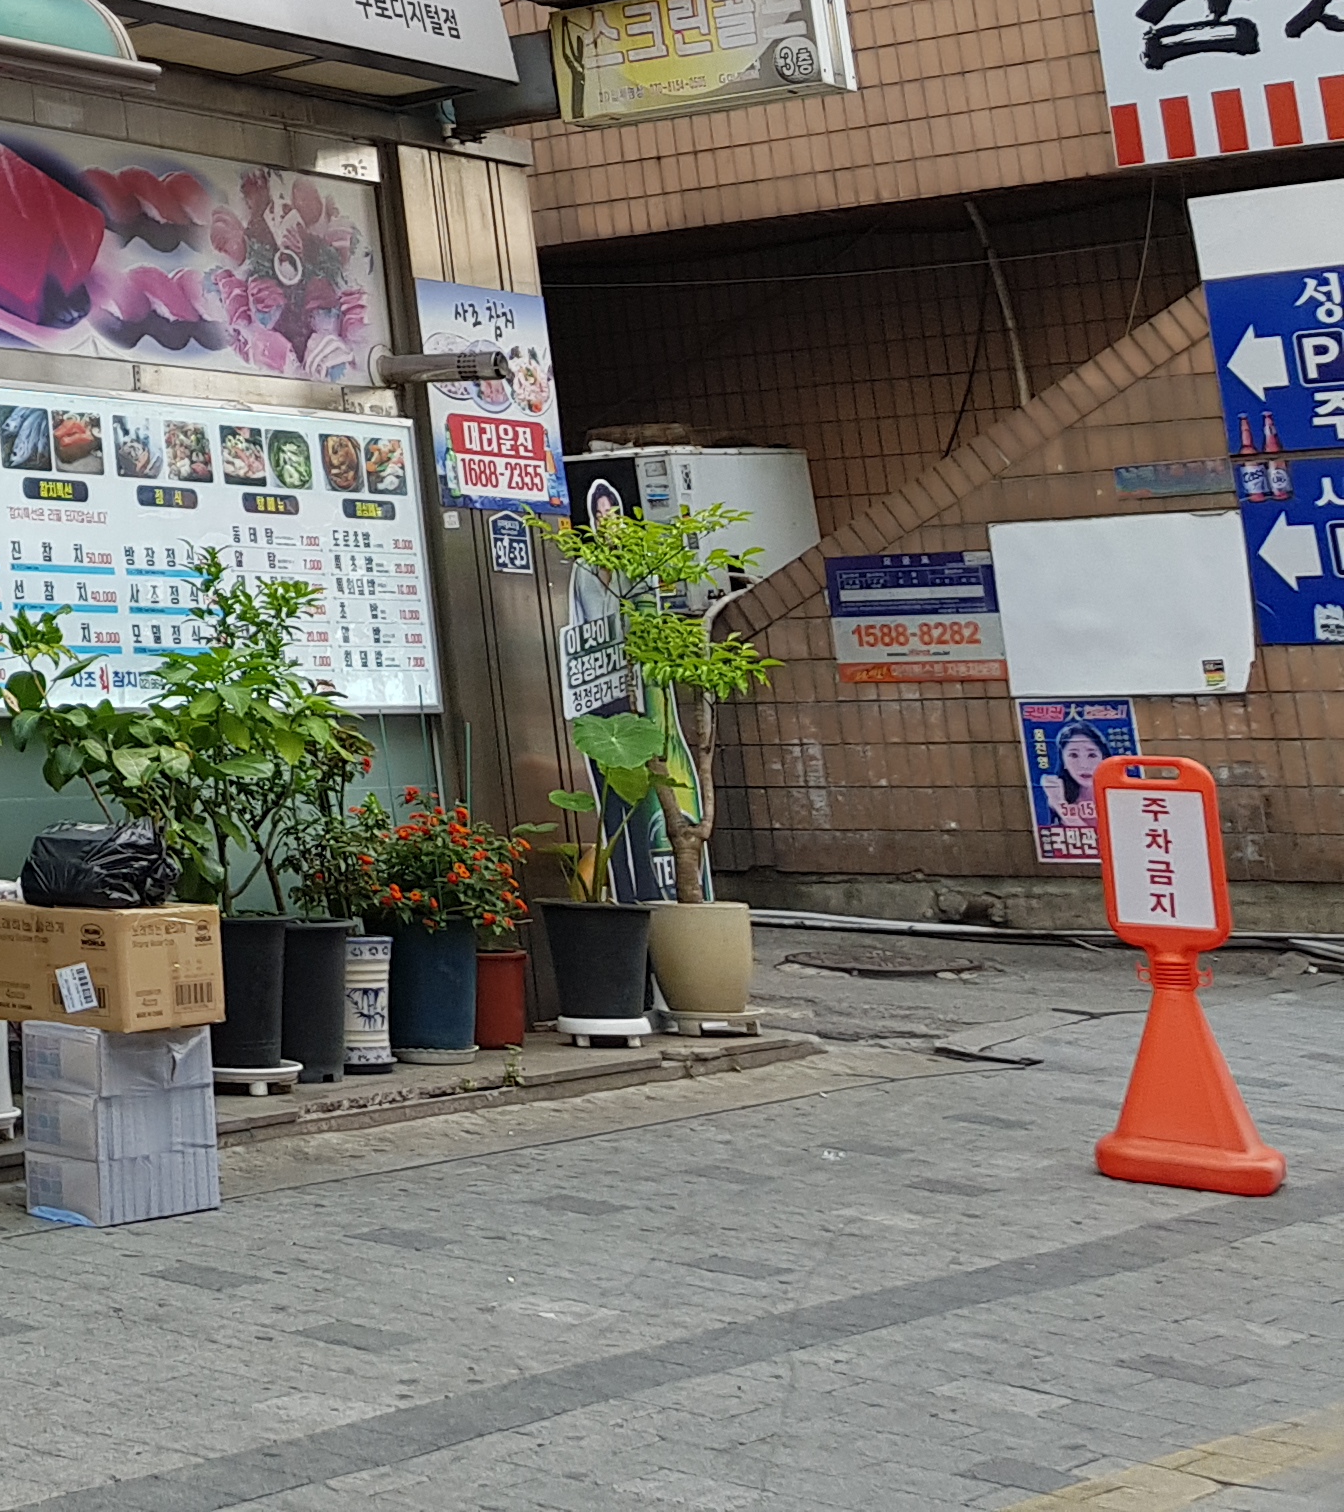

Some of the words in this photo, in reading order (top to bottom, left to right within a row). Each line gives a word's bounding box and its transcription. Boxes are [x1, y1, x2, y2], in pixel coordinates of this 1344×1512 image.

[778, 45, 814, 80] 3층
[454, 301, 482, 328] 사조
[485, 298, 516, 340] 참치
[1302, 336, 1340, 379] P
[462, 419, 534, 458] 대리운전
[460, 456, 545, 493] 1688-2355
[566, 626, 582, 654] 이
[585, 617, 611, 648] 맛이
[851, 620, 982, 648] 1588-8282
[1141, 797, 1177, 918] 주차금지
